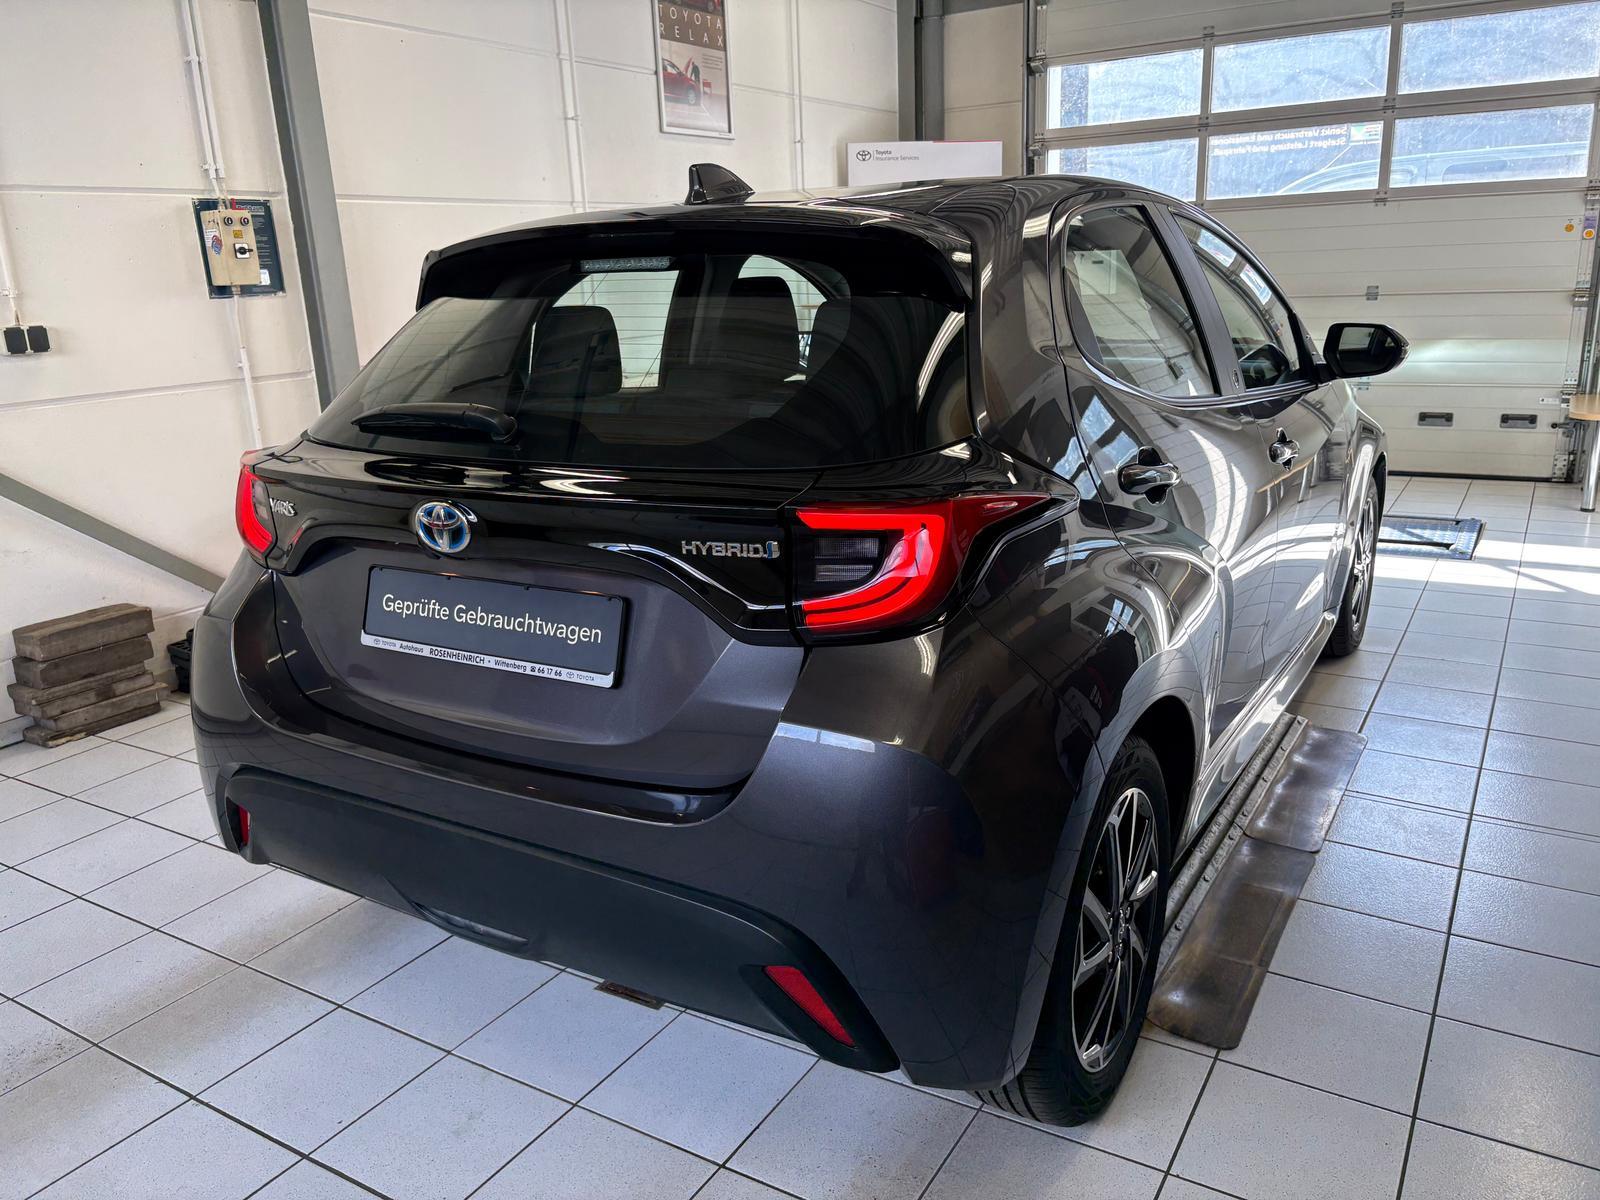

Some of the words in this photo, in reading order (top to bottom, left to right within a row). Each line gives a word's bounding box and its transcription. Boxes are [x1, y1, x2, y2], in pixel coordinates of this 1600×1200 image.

[659, 4, 722, 30] TOYOTA
[659, 22, 723, 48] RELAX
[681, 540, 764, 558] HYBRID
[382, 593, 449, 620] Geprüfte
[453, 604, 602, 645] Gebrauchtwagen
[381, 640, 397, 648] TOYOTA
[399, 643, 424, 654] Autohaus
[429, 647, 485, 665] ROSENHEINRICH
[494, 659, 528, 672] Wittenberg
[537, 665, 546, 674] 66
[546, 668, 553, 676] 17
[554, 669, 563, 677] 66
[576, 673, 595, 682] TOYOTA
